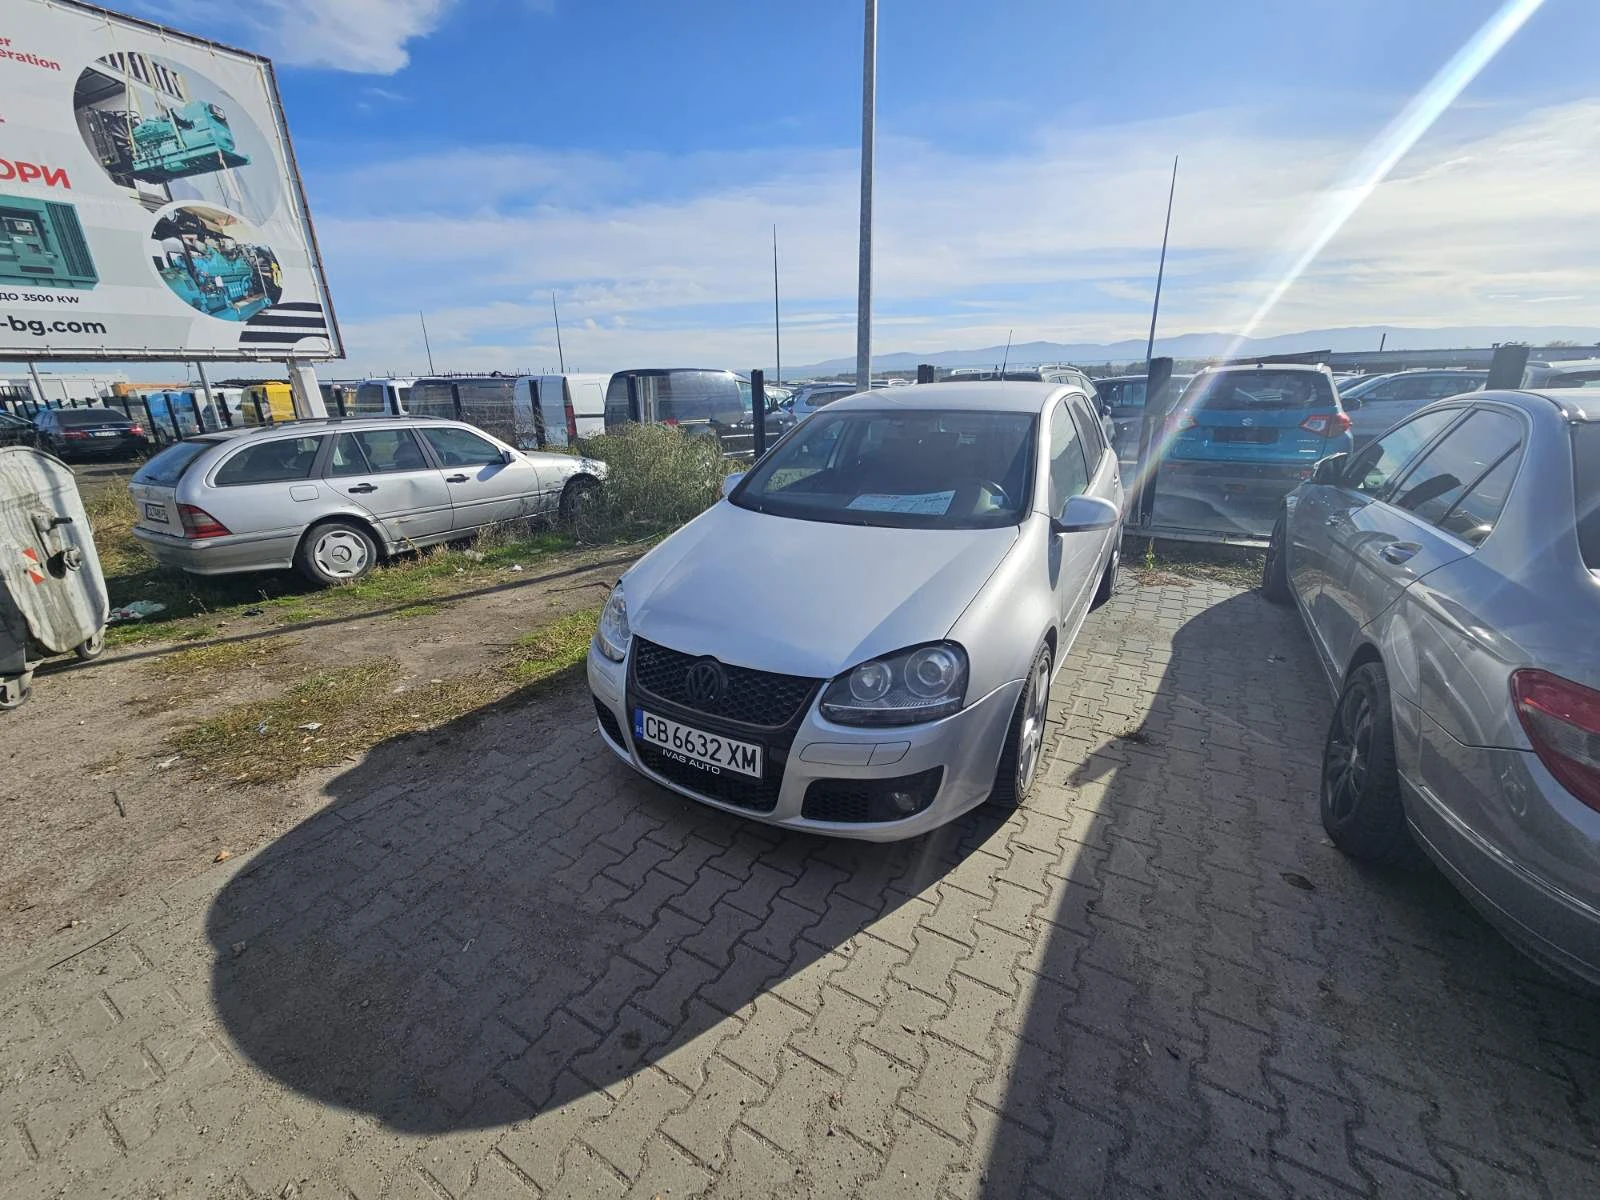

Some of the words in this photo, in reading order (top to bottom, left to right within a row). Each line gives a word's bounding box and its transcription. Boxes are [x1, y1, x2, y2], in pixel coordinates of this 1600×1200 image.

[21, 293, 54, 303] 3500
[57, 295, 79, 304] KW
[0, 314, 107, 336] -bg.com
[645, 716, 669, 743] CB
[672, 726, 722, 763] 6632
[727, 742, 757, 773] XM
[662, 748, 687, 763] IVAS
[689, 759, 720, 775] AUTO
